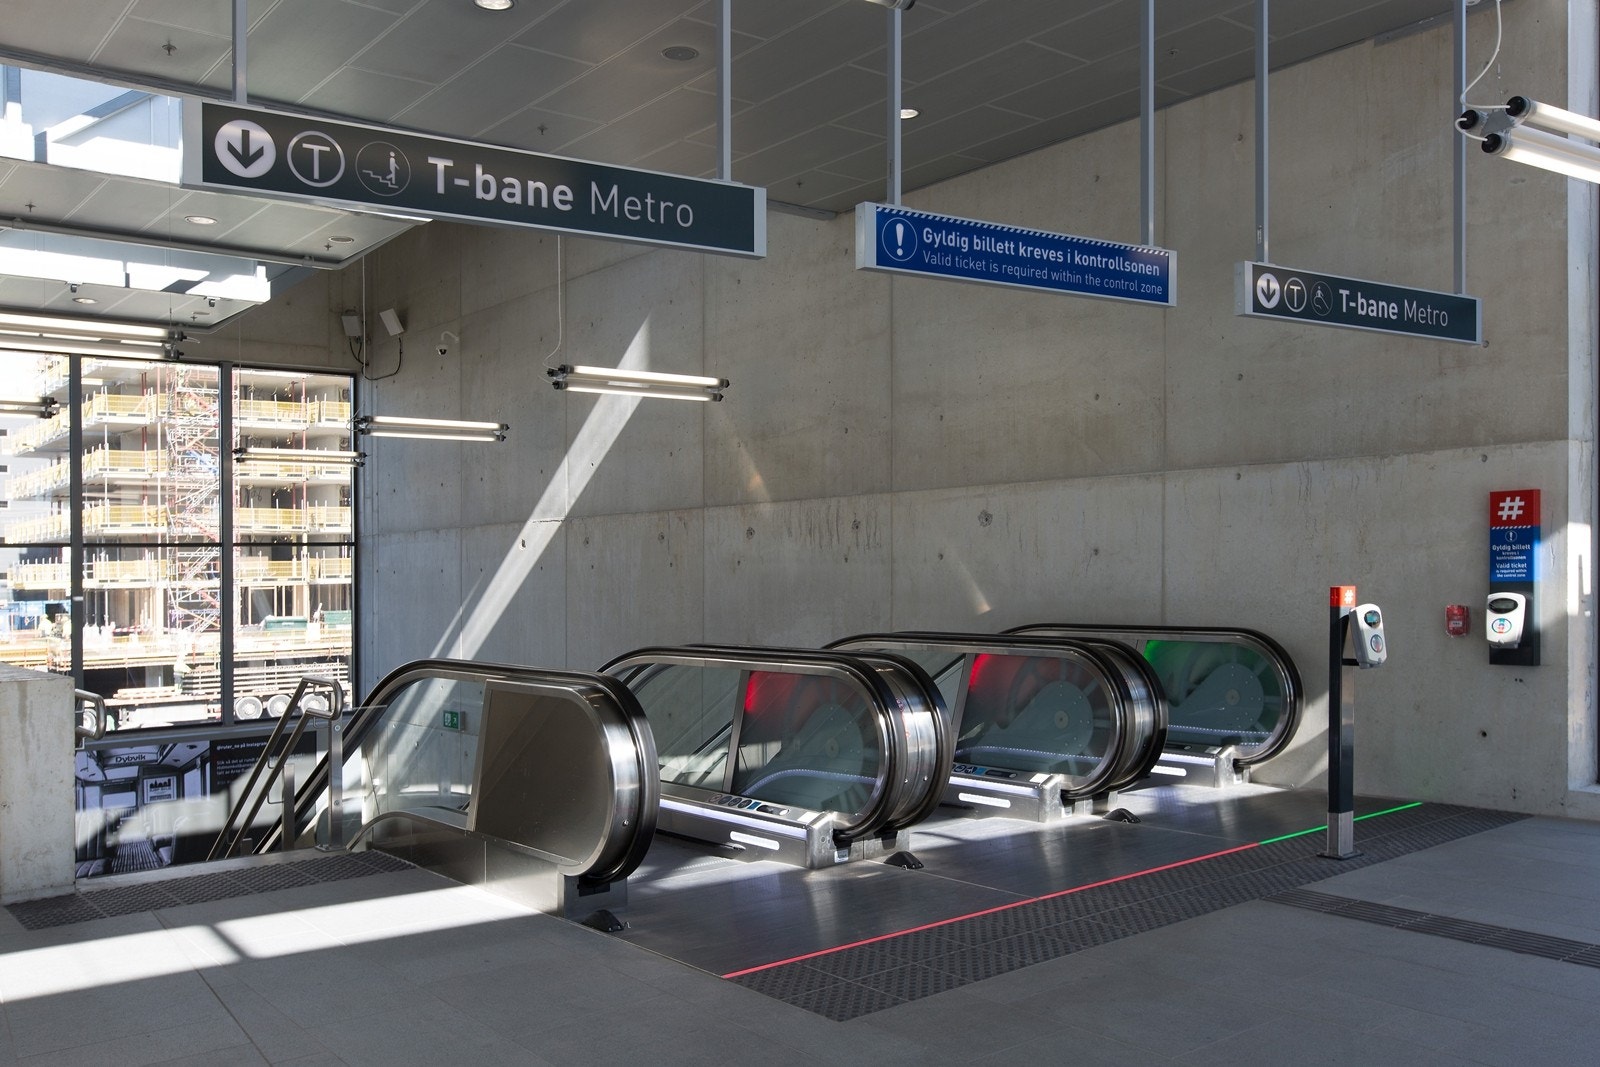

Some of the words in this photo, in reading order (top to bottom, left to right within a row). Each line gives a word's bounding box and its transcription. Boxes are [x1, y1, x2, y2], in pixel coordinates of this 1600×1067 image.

[427, 156, 574, 212] T-bane
[590, 181, 694, 228] Metro
[923, 227, 969, 252] Gyldig
[973, 235, 1015, 256] billett
[1019, 242, 1064, 262] kreves
[1067, 249, 1071, 264] i
[1074, 250, 1160, 276] kontrollsonen
[923, 250, 952, 267] Valid
[955, 255, 986, 271] ticket
[989, 260, 999, 273] is
[1002, 264, 1048, 280] required
[1051, 270, 1082, 284] within
[1085, 273, 1101, 287] the
[1103, 278, 1139, 292] control
[1140, 283, 1163, 295] zone
[1339, 289, 1398, 320] T-bane
[1404, 299, 1448, 327] Metro
[1498, 496, 1525, 520] #
[115, 754, 146, 763] Dybvik
